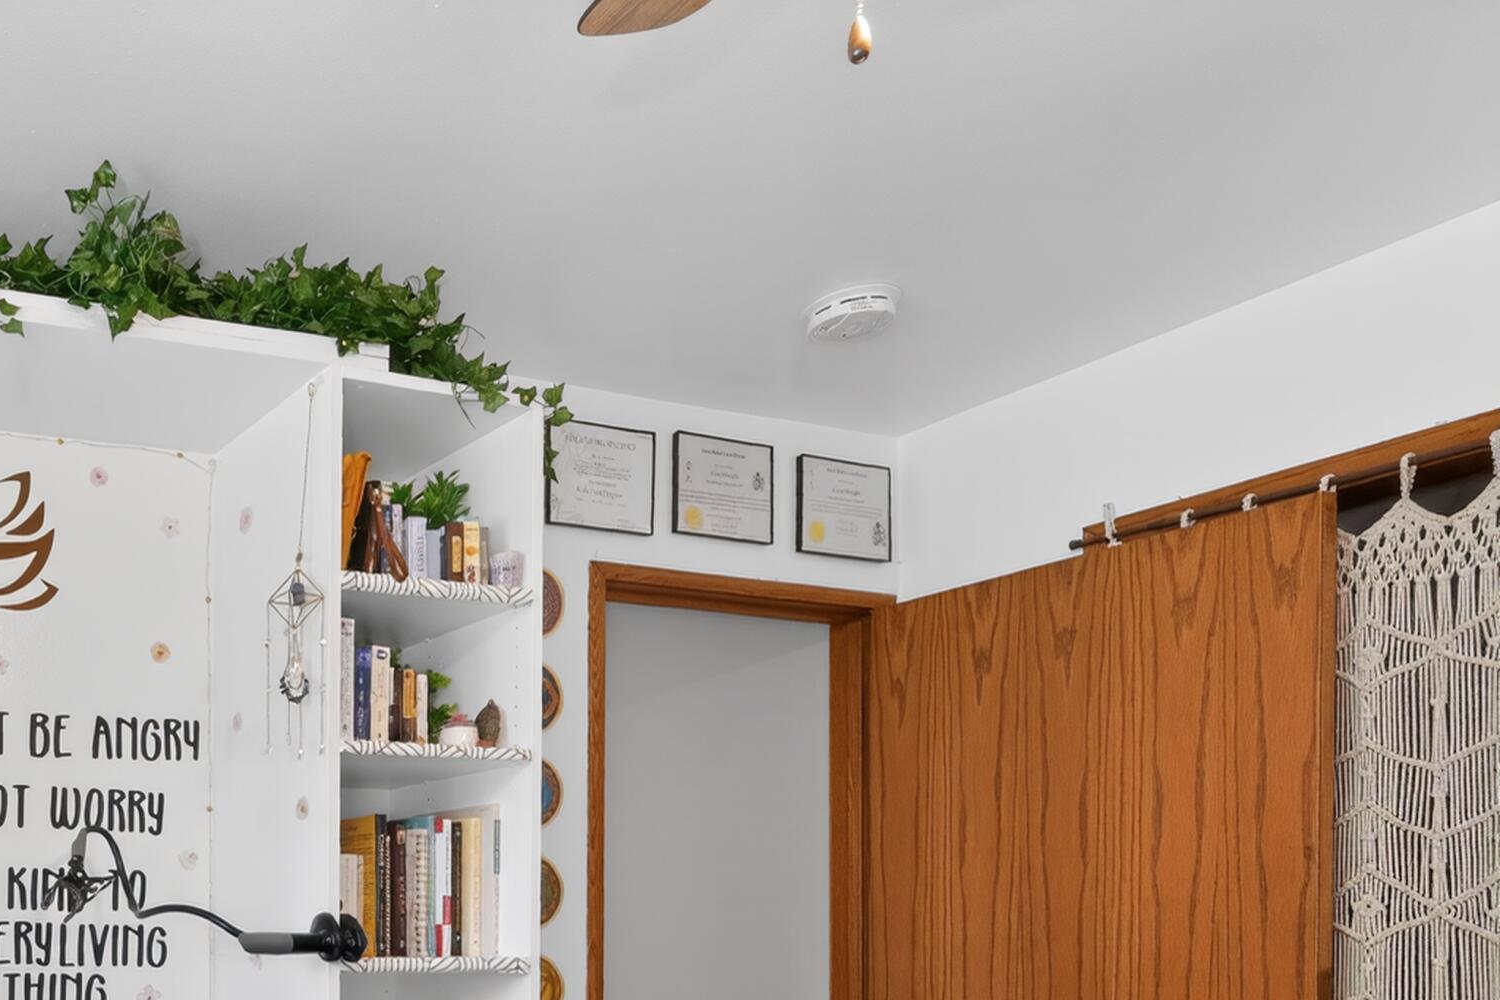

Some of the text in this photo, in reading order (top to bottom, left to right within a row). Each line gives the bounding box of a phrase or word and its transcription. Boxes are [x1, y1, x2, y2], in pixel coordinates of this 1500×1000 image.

[29, 712, 72, 759] BE
[91, 715, 200, 762] ANGRY
[50, 786, 165, 836] WORRY
[7, 866, 86, 912] KIN
